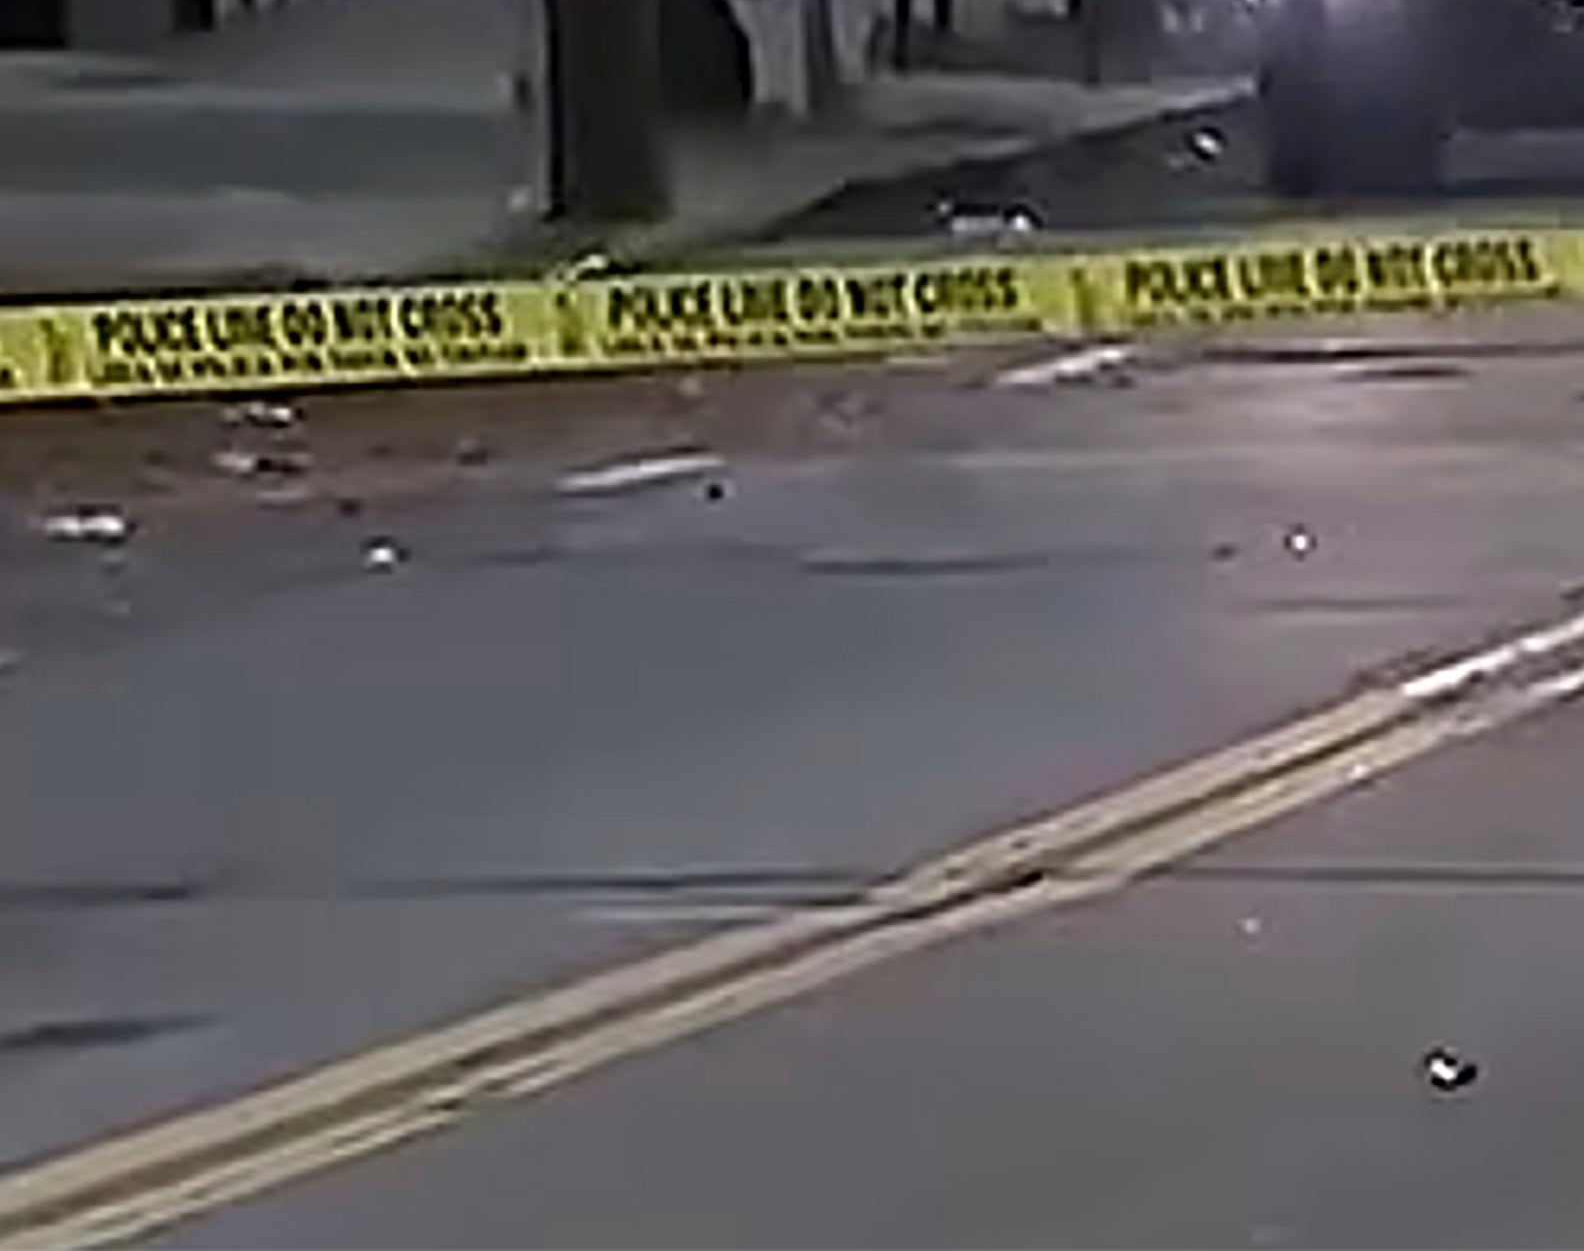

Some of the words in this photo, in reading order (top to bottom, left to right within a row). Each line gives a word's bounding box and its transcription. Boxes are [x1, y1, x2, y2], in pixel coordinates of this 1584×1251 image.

[94, 309, 200, 353] POLICE
[400, 293, 502, 336] CROSS
[609, 286, 711, 329] POLICE
